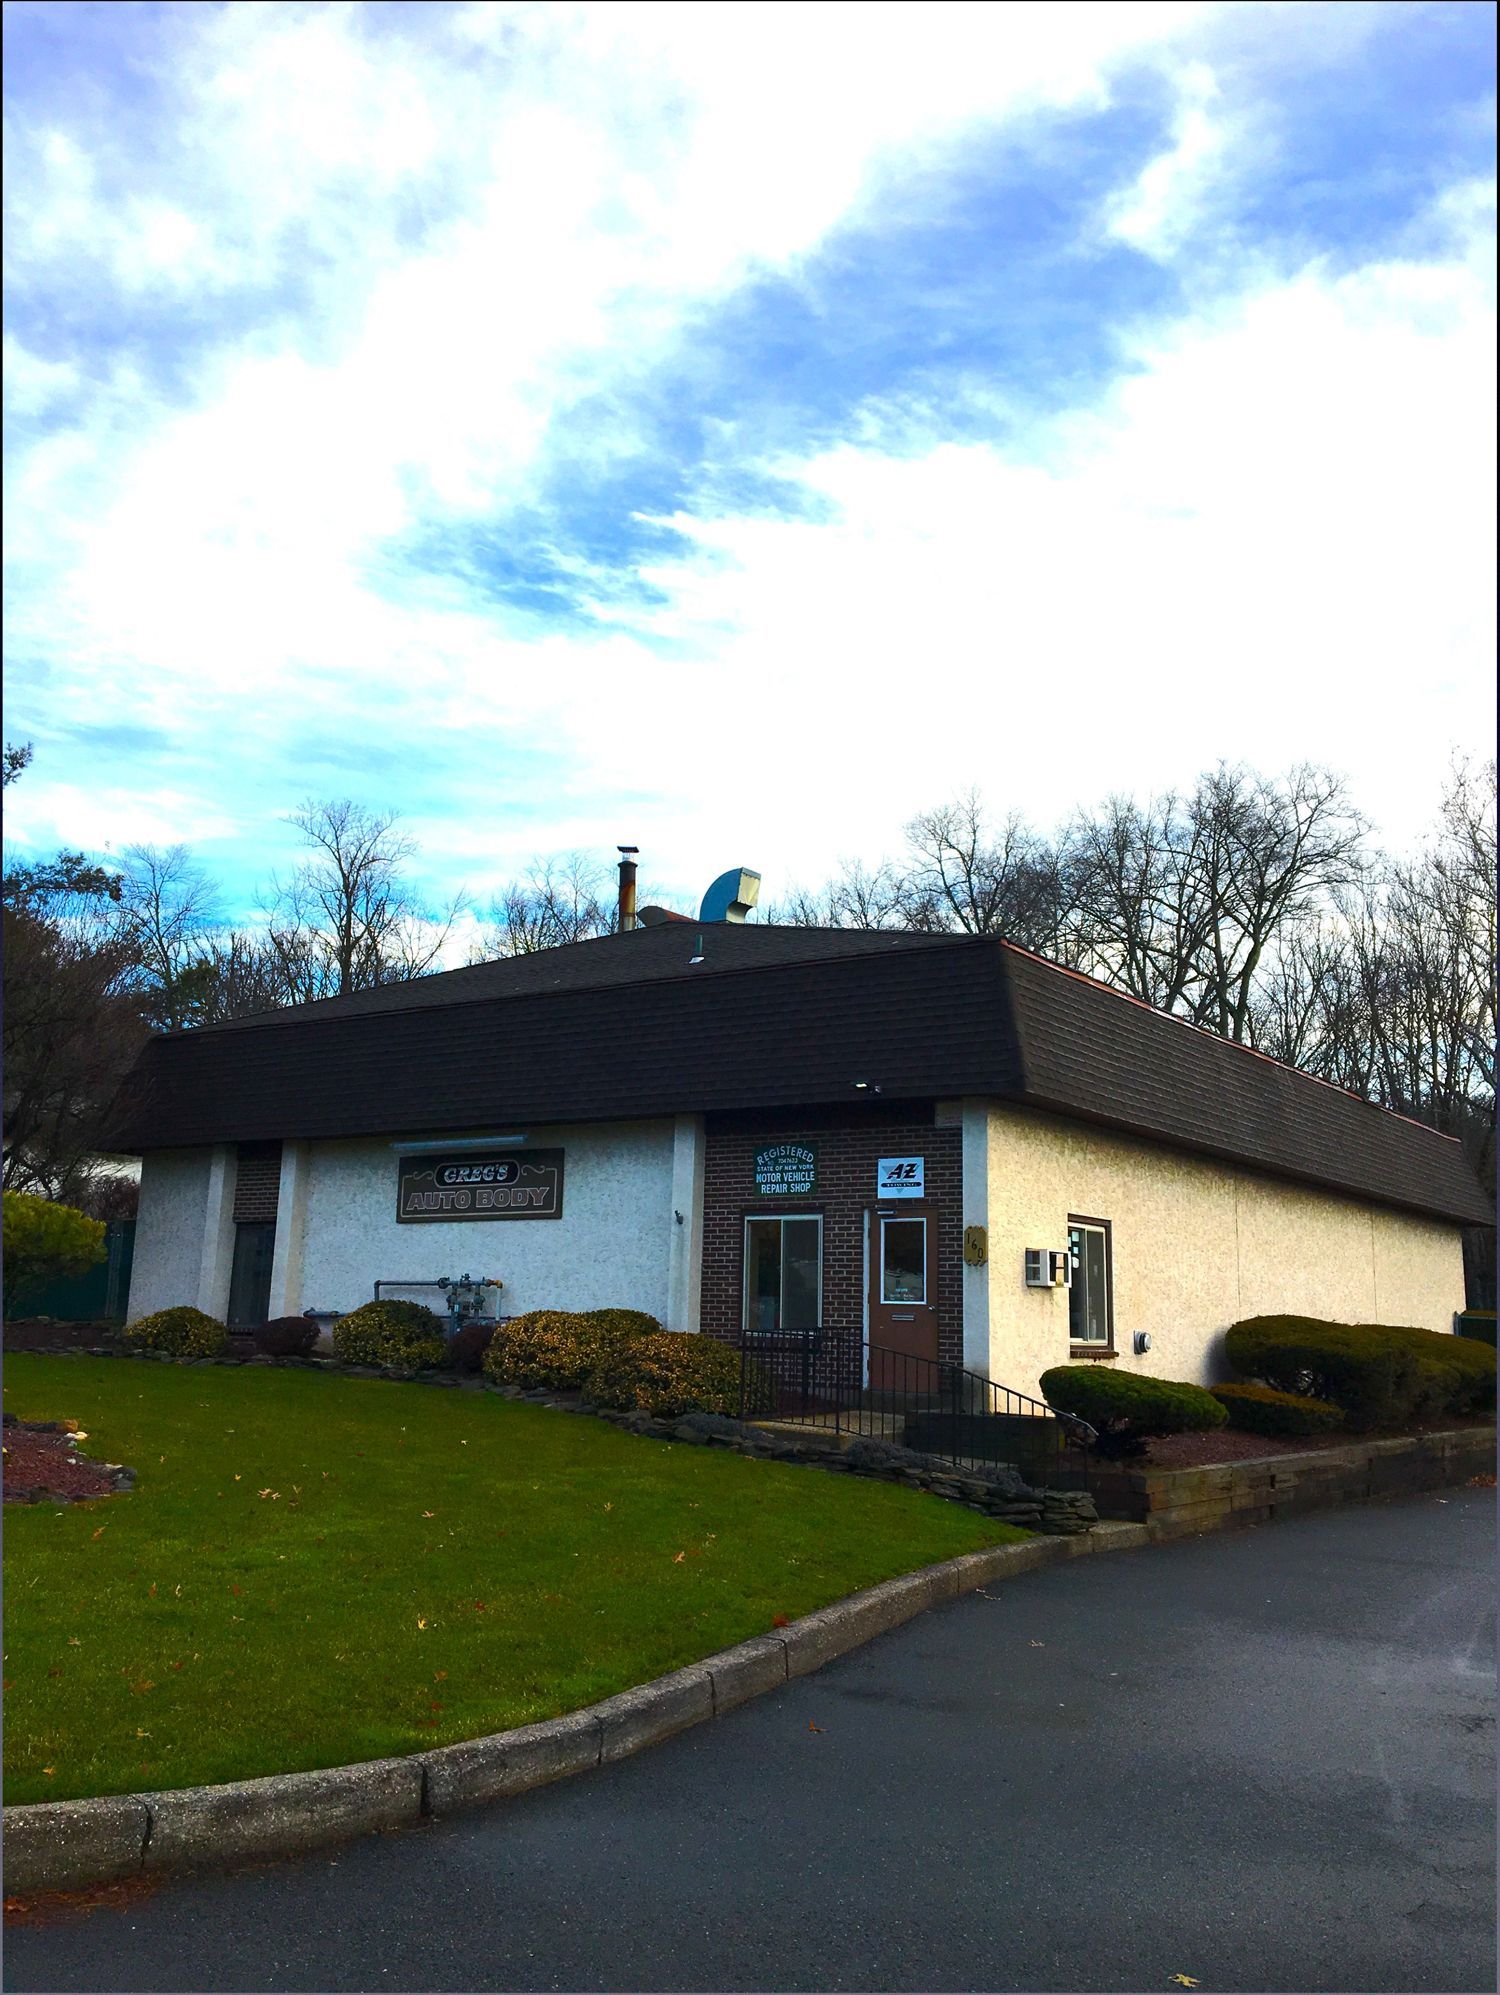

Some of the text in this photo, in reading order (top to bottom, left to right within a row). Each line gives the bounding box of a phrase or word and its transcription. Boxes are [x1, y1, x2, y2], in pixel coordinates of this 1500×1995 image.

[757, 1145, 814, 1165] REGISTERED
[443, 1164, 509, 1183] GREG'S
[756, 1171, 815, 1183] MOTOR VEHICLE
[886, 1163, 918, 1179] AZ
[761, 1182, 811, 1194] REPAIR SHOP
[406, 1187, 550, 1211] AUTO BODY
